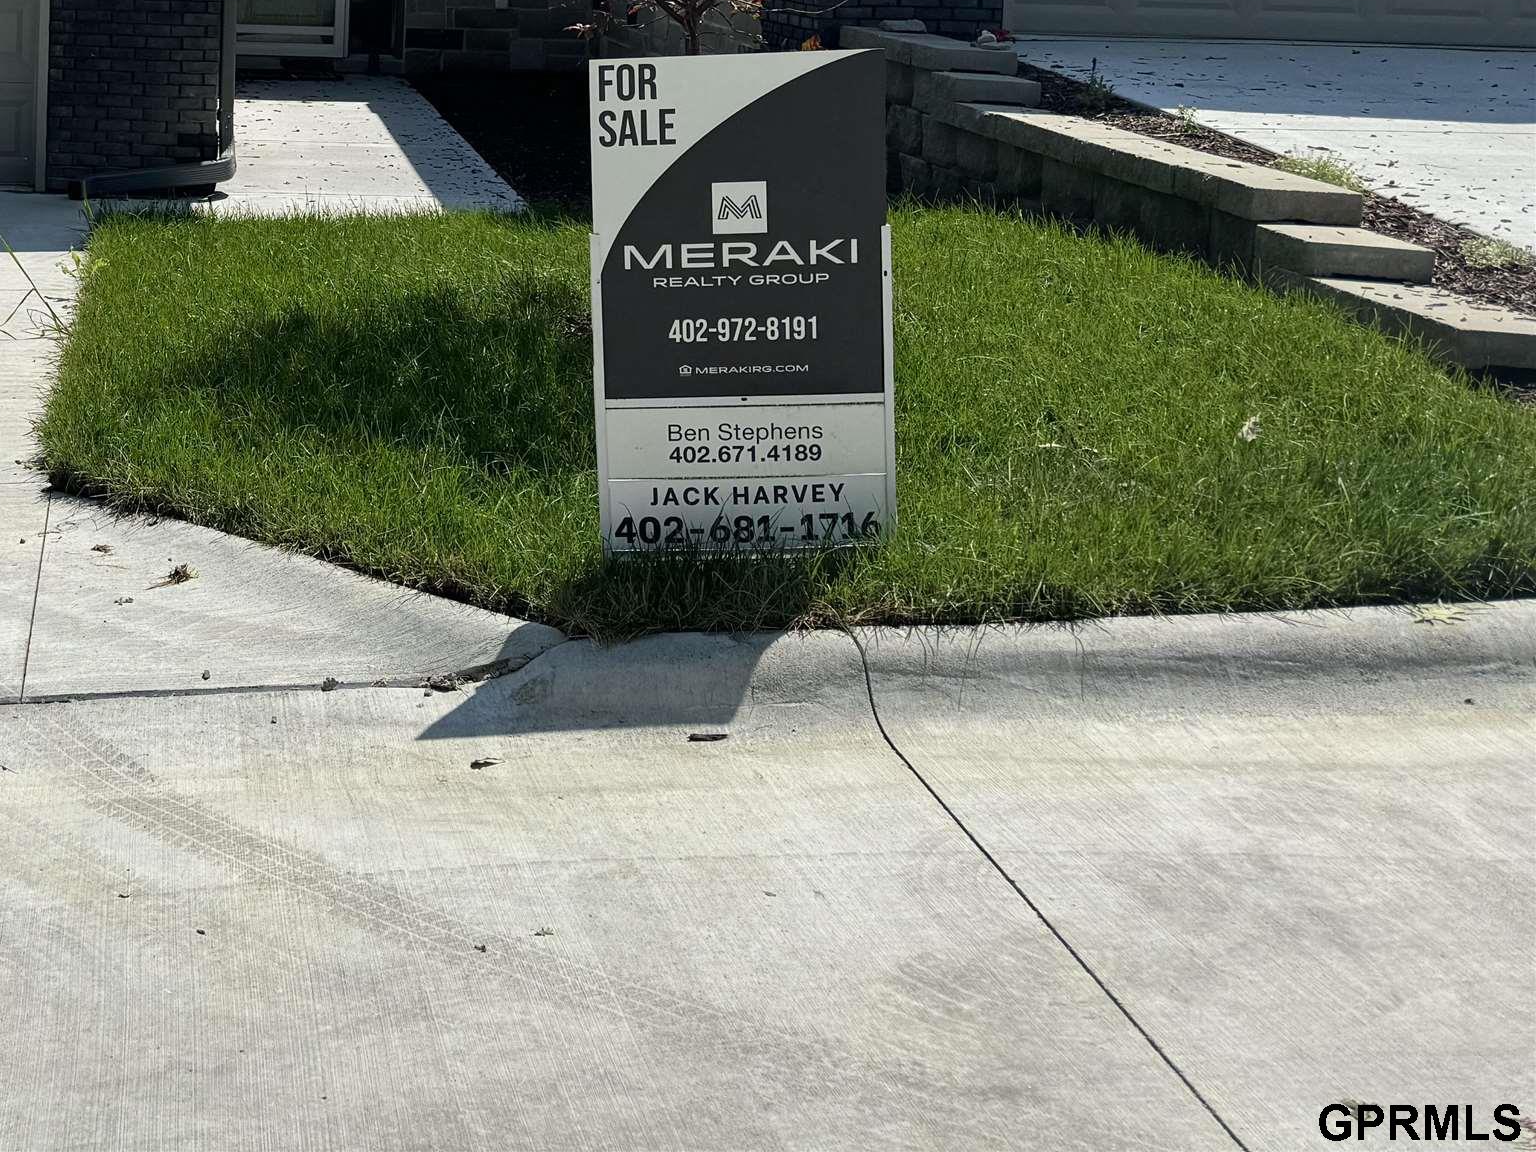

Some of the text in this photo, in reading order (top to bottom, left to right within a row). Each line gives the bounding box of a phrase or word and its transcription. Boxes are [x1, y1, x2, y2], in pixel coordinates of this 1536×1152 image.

[597, 63, 657, 102] FOR
[598, 108, 677, 148] SALE
[623, 238, 858, 271] MERAKI
[653, 273, 830, 288] REALTY GROUP
[668, 315, 818, 343] 402-972-8191
[695, 364, 809, 375] MERAKIRG.COM
[668, 422, 823, 445] Ben Stephens
[669, 444, 822, 464] 402.671.4189
[650, 483, 846, 507] JACK HARVEY
[614, 511, 882, 545] 402-681-1716
